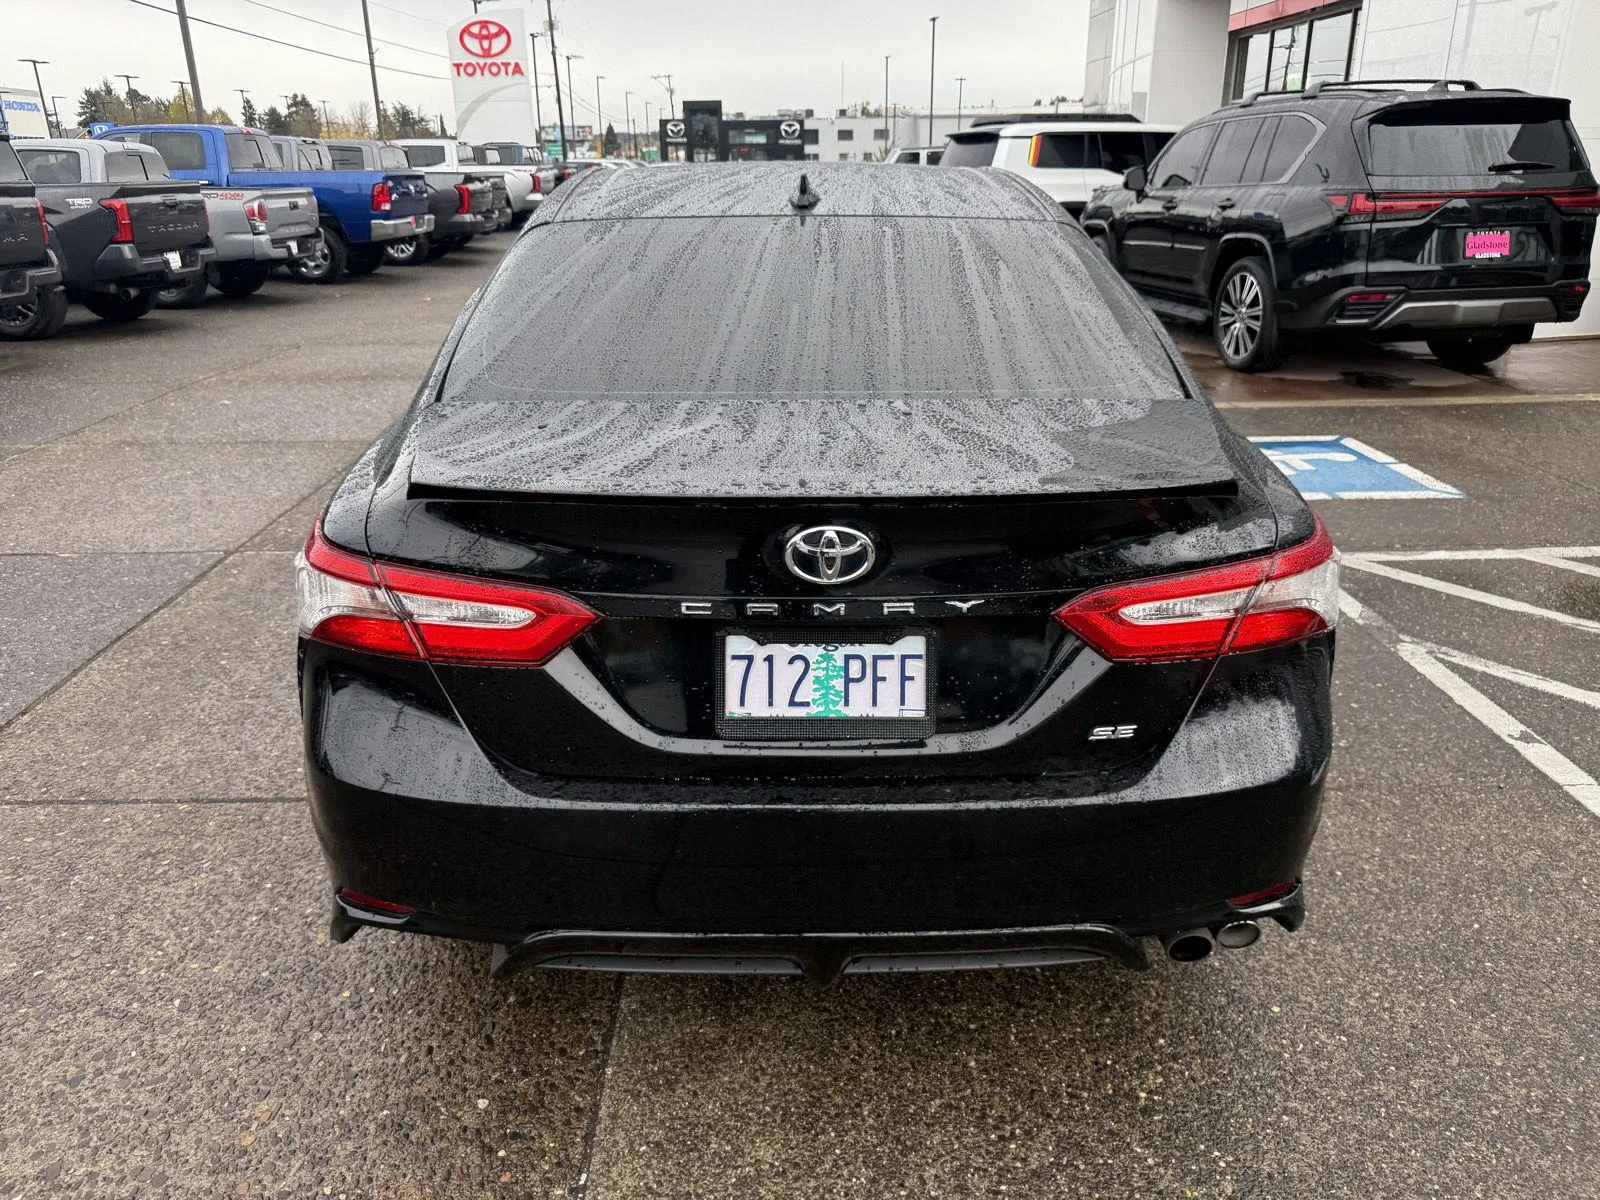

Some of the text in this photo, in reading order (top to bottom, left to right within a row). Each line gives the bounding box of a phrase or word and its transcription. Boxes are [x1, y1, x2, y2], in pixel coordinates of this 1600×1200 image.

[452, 61, 525, 77] TOYOTA
[3, 100, 41, 112] HONDA
[65, 198, 93, 206] TRD
[1466, 240, 1508, 250] Gladstone
[680, 599, 985, 616] CAMRY
[730, 653, 924, 708] 712 PFF
[1088, 724, 1138, 741] SE
